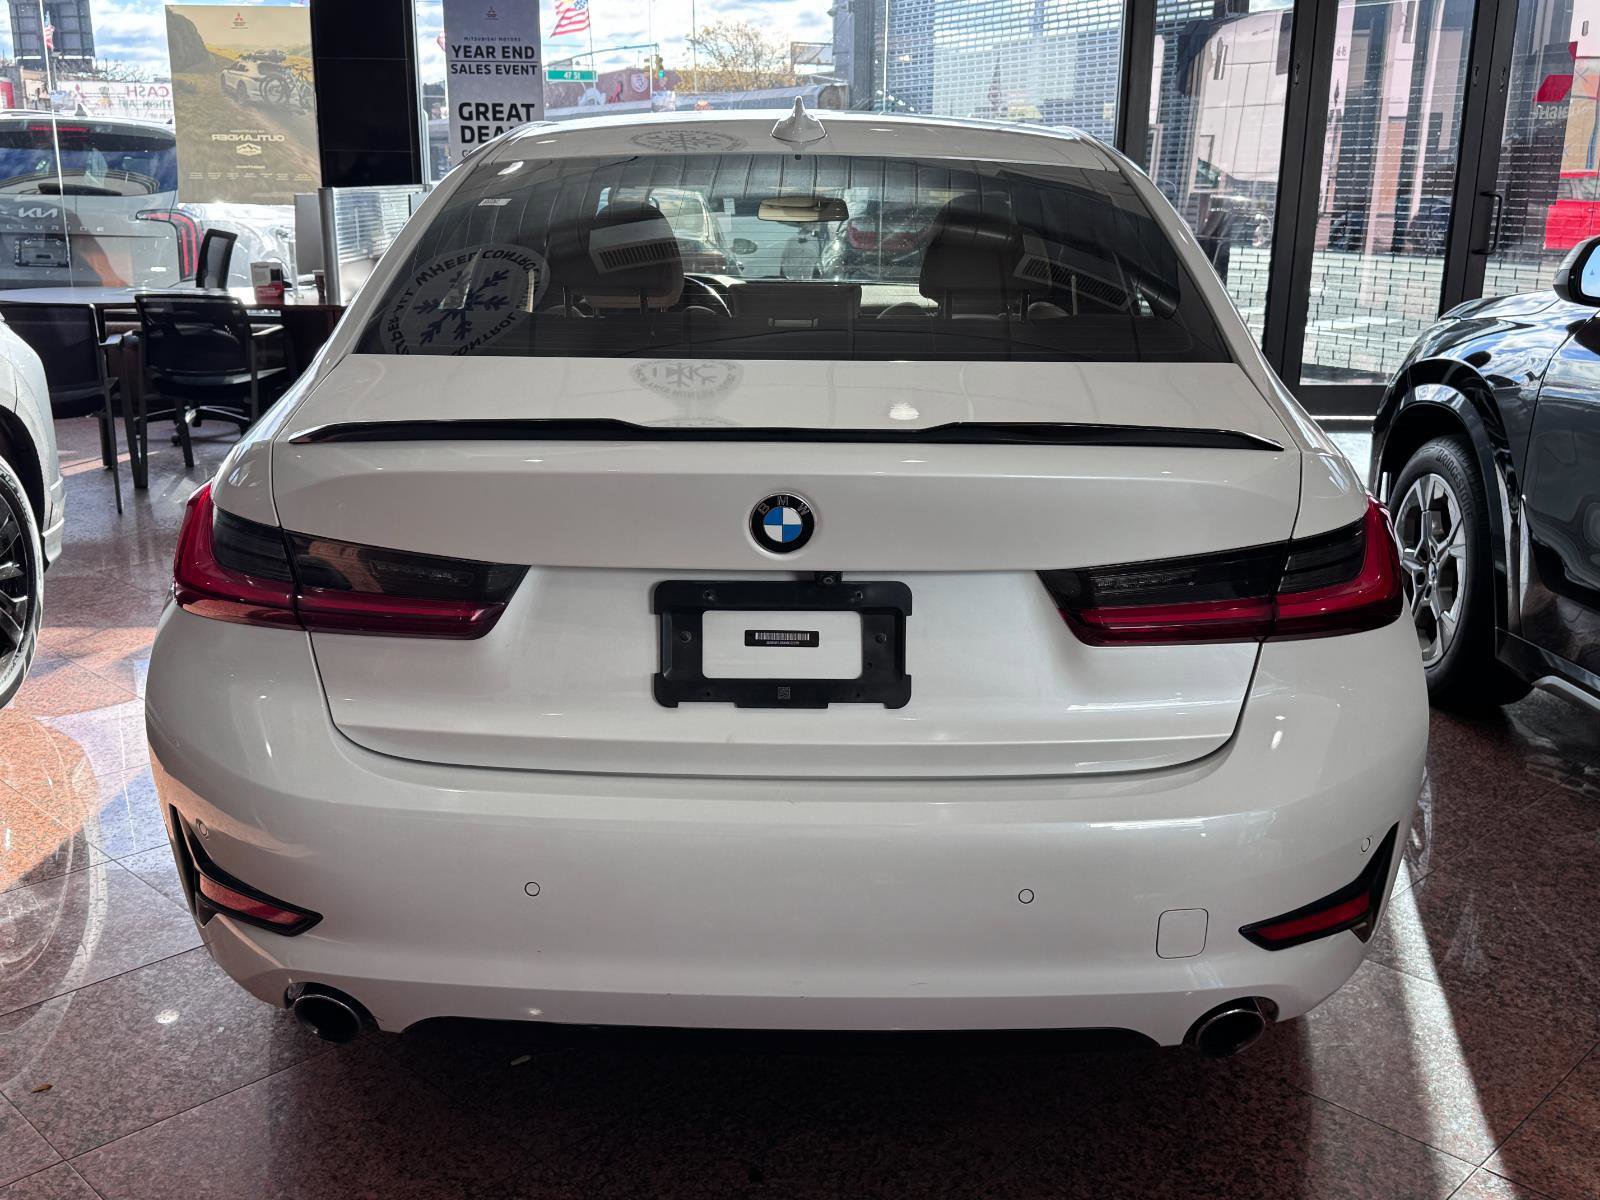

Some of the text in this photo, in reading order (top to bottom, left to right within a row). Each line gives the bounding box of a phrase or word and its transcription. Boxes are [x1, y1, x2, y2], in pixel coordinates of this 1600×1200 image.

[451, 44, 535, 60] YEAR END
[450, 63, 538, 76] SALES EVENT
[458, 102, 535, 122] GREAT
[460, 125, 515, 144] DEA
[18, 207, 58, 218] KIA
[1436, 449, 1472, 519] BRIDGESTONE
[757, 495, 810, 515] BMW
